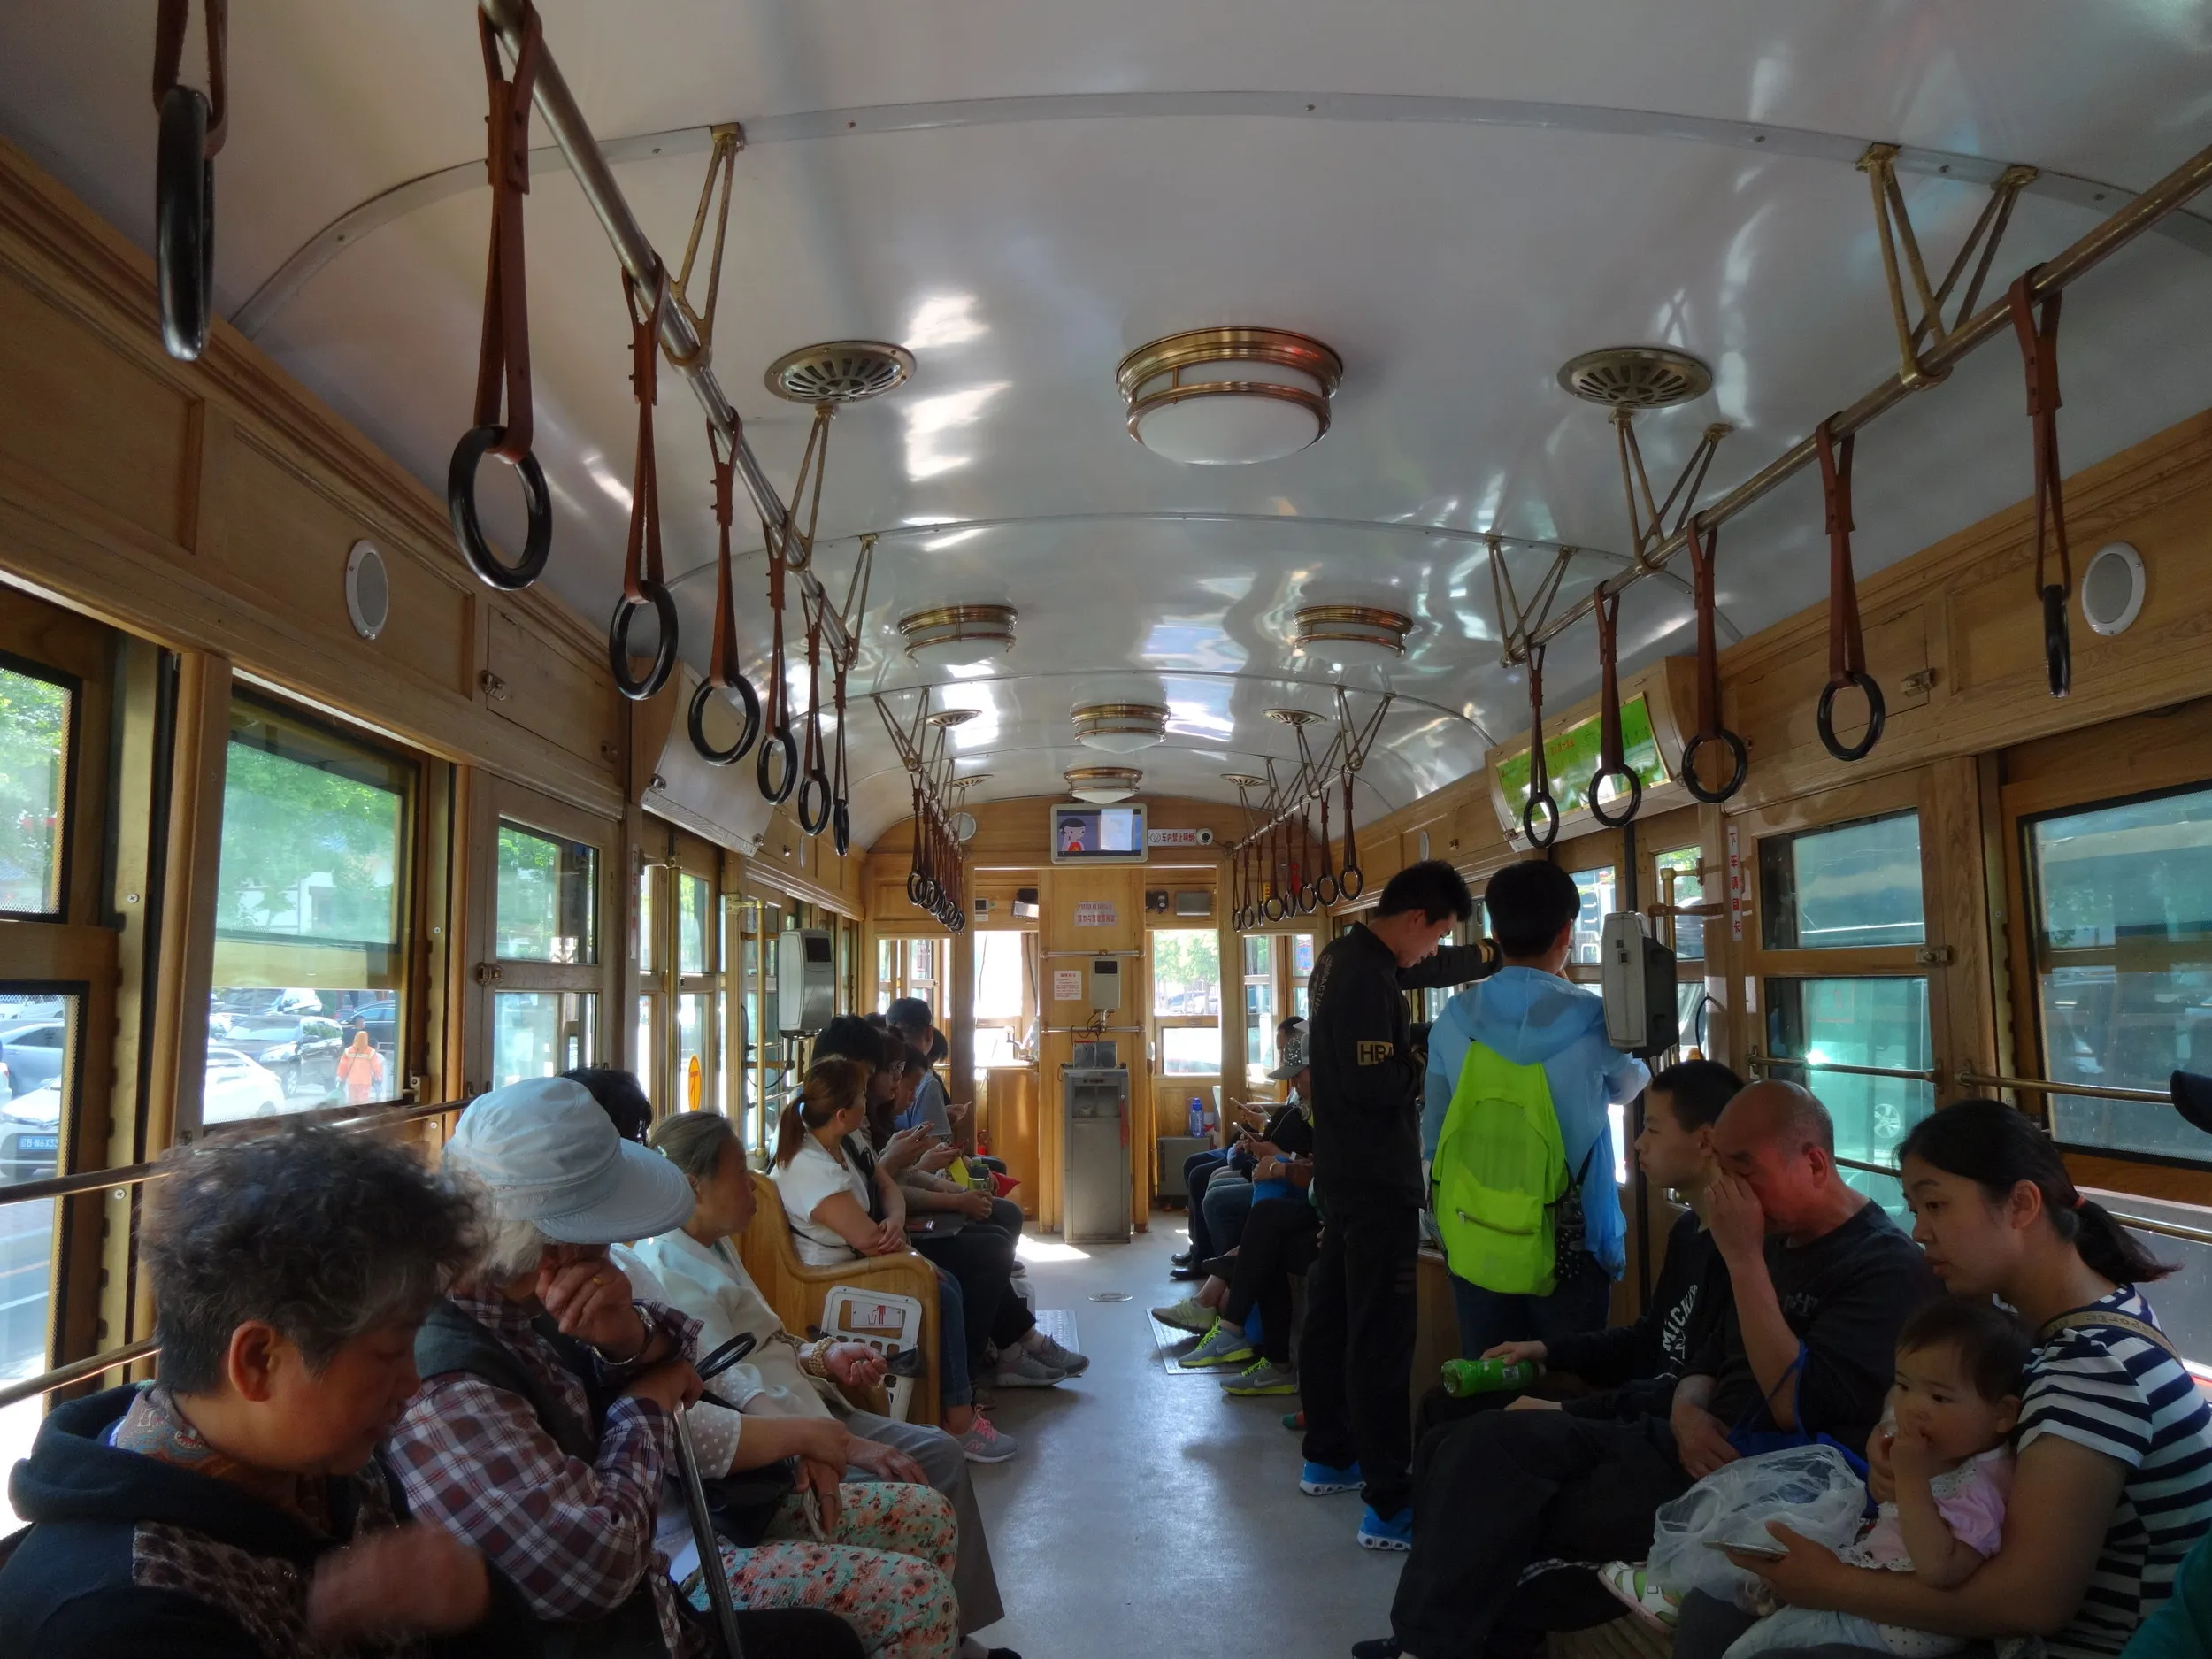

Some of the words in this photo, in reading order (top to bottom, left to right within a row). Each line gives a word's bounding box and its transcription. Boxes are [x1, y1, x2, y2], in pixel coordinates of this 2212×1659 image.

[1161, 833, 1194, 843] 车内禁止吸烟
